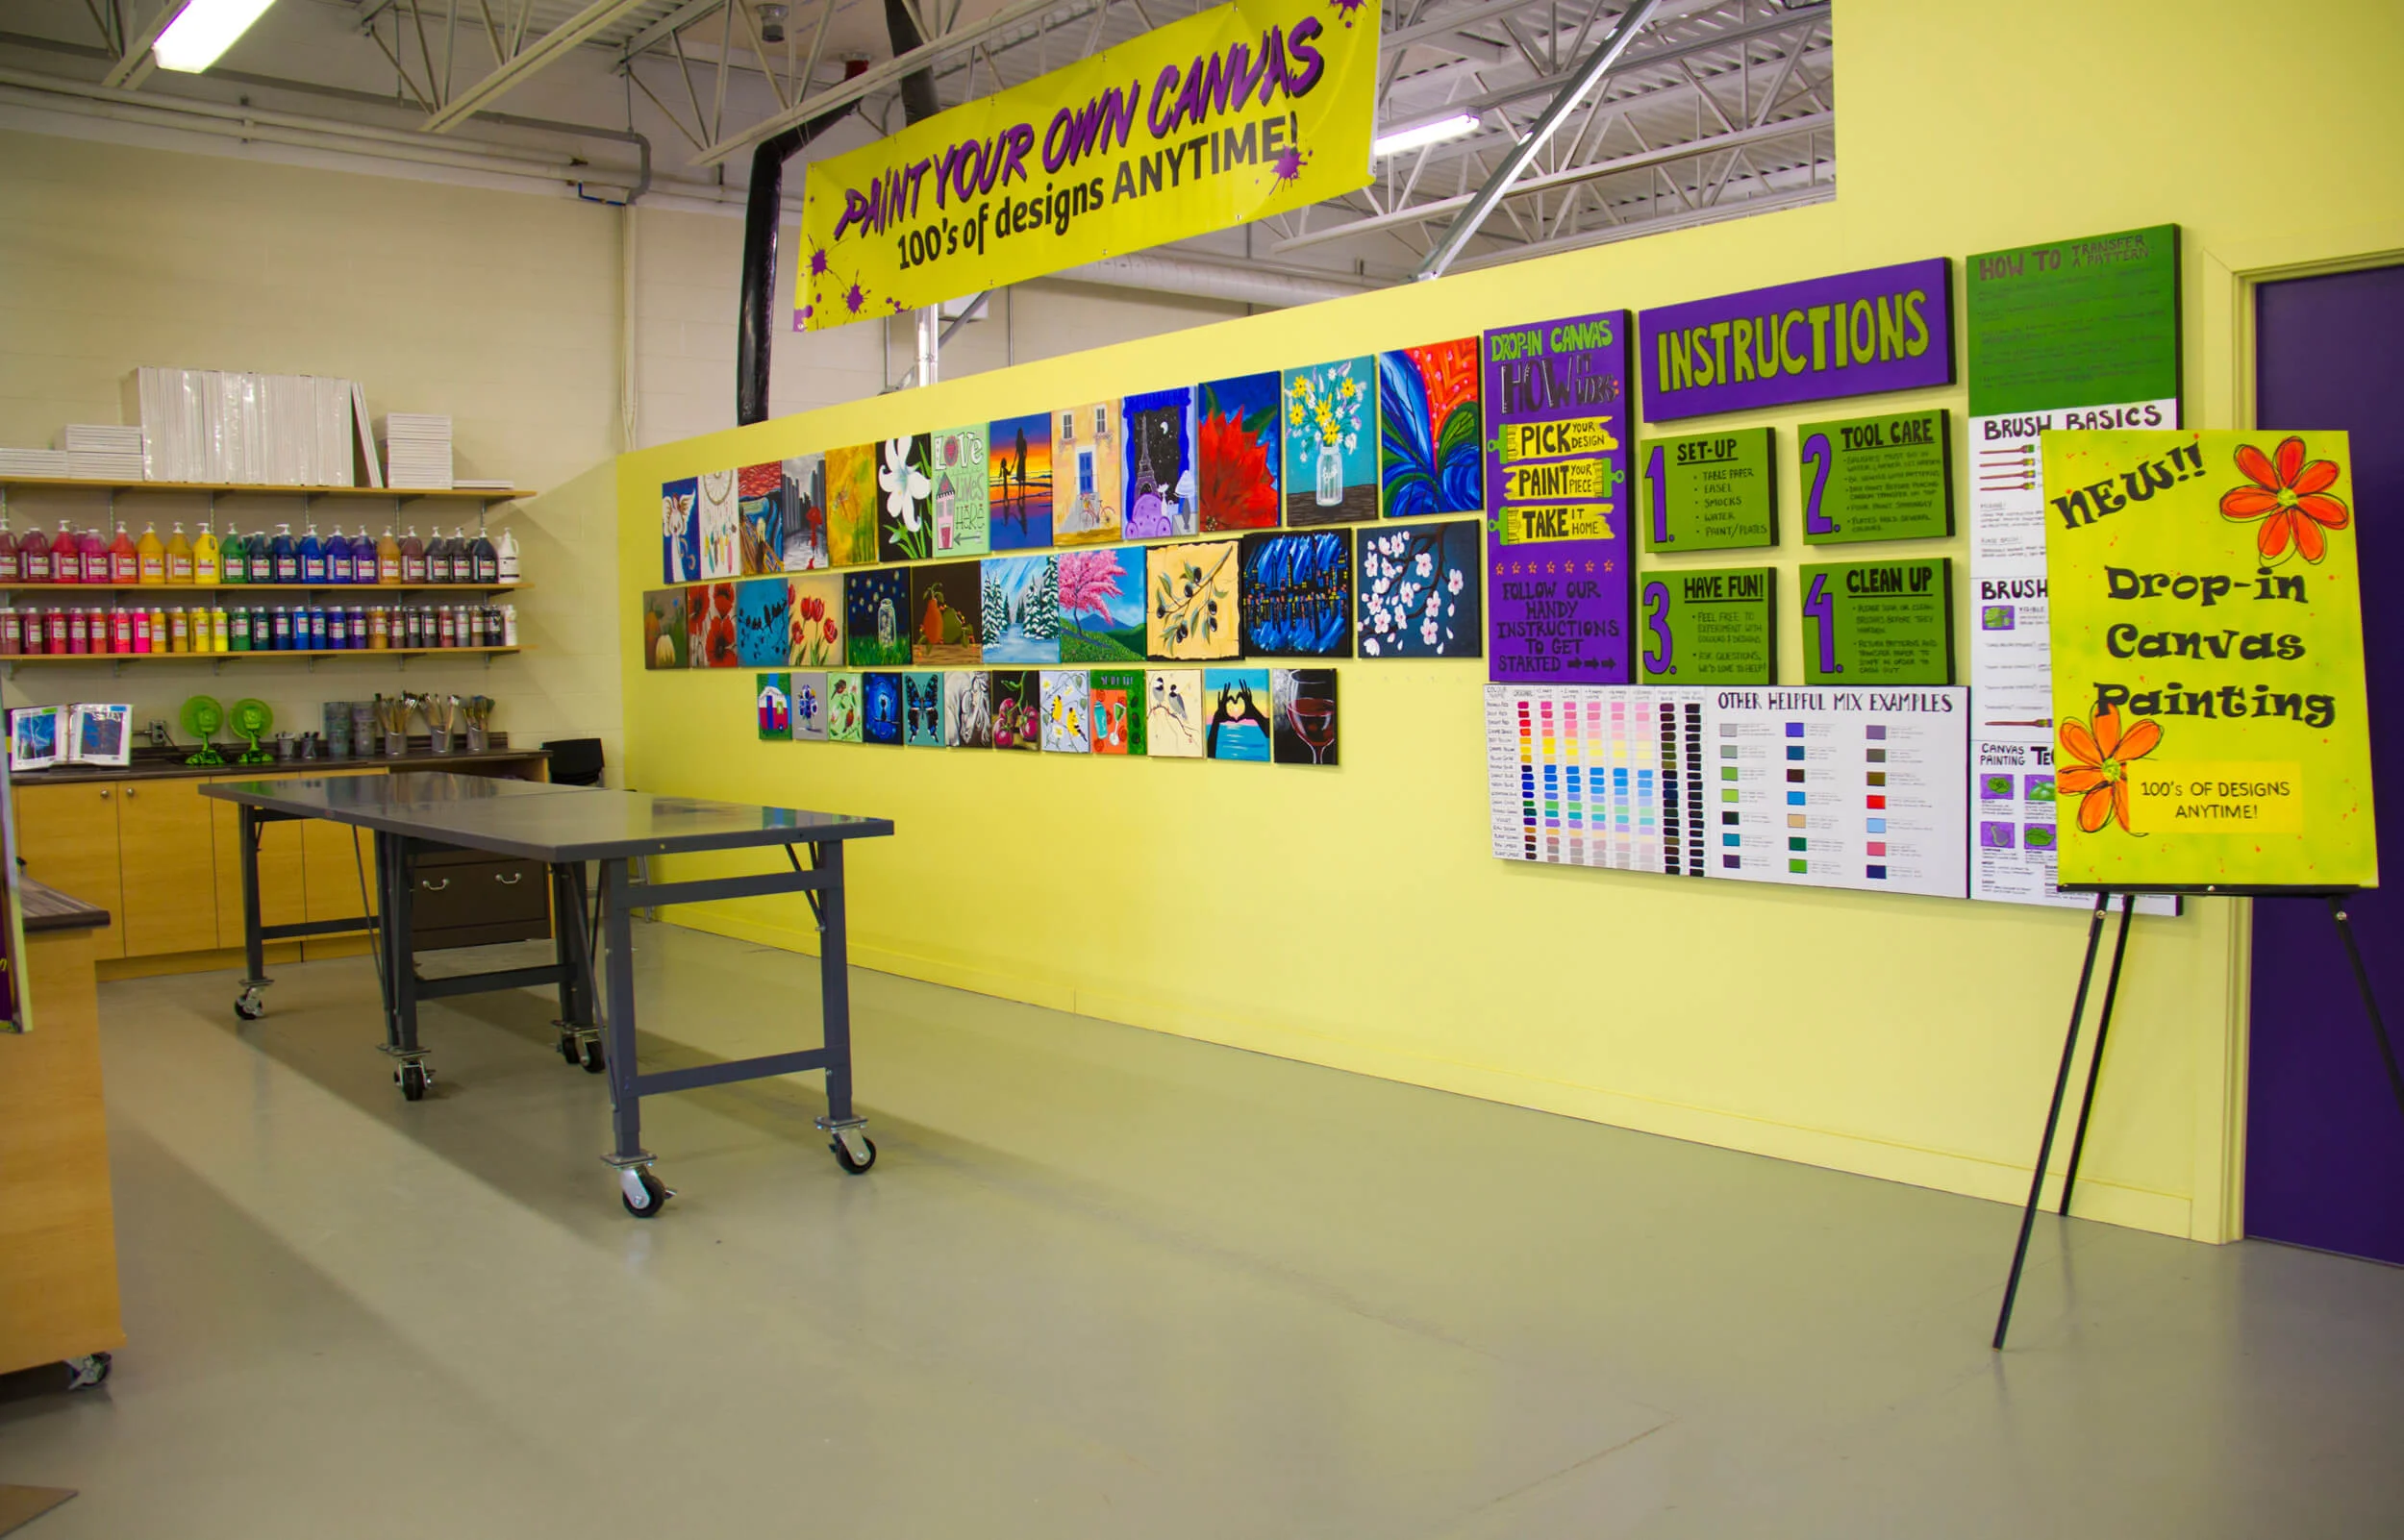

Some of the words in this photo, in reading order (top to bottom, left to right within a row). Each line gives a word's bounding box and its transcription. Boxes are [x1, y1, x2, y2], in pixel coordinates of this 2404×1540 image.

[834, 155, 931, 240] PAINT
[932, 123, 1035, 209] YOUR
[1041, 81, 1140, 173] OWN
[1147, 16, 1325, 138] CANVAS
[897, 218, 958, 270] 100's
[963, 214, 986, 255] of
[995, 177, 1104, 236] designs
[1111, 112, 1298, 205] ANYTIME!
[1979, 253, 2024, 281] HOW
[2031, 249, 2061, 271] TO
[2071, 234, 2146, 257] TRANSFER
[2072, 258, 2081, 268] A
[2087, 246, 2149, 266] PATTERN
[1490, 330, 1542, 361] DROP-IN
[1550, 320, 1613, 353] CANVAS
[1657, 289, 1929, 393] INSTRUCTIONS
[1501, 356, 1572, 414] HOW
[1572, 421, 1595, 433] YOUR
[1984, 414, 2051, 440] BRUSH
[2066, 405, 2163, 430] BASICS
[1521, 422, 1572, 456] PICK
[1571, 434, 1605, 448] DESIGN
[1841, 423, 1884, 449] TOOL
[1891, 418, 1933, 444] CARE
[1677, 438, 1738, 461] SET-UP
[1518, 464, 1569, 497] PAINT
[1570, 463, 1592, 477] YOUR
[1702, 470, 1727, 482] TABLE
[1729, 468, 1754, 480] PAPER
[1569, 479, 1592, 493] PIECE
[2050, 441, 2207, 530] NEW!!
[1704, 496, 1742, 509] SMOCKS
[1522, 509, 1568, 538] TAKE
[1572, 509, 1585, 520] IT
[1572, 521, 1599, 535] HOME
[1685, 576, 1722, 599] HAVE
[1729, 575, 1764, 597] FUN!
[1846, 567, 1903, 593] CLEAN
[1909, 566, 1932, 592] UP
[1981, 579, 2048, 600] BRUSH
[2104, 564, 2309, 608] Drop-in
[1502, 582, 1557, 600] FOLLOW
[1566, 581, 1601, 599] OUR
[1525, 601, 1578, 620] HANDY
[1497, 619, 1619, 638] INSTRUCTIONS
[1525, 638, 1544, 655] TO
[1551, 637, 1584, 655] GET
[2107, 623, 2306, 660] Canvas
[1498, 656, 1561, 672] STARTED
[1717, 691, 1763, 709] OTHER
[1767, 691, 1826, 710] HELPFUL
[1834, 692, 1864, 710] MIX
[1869, 693, 1953, 712] EXAMPLES
[2092, 682, 2336, 728] Painting
[1982, 743, 2024, 755] CANVAS
[2031, 746, 2054, 765] TE
[1980, 755, 2026, 766] PAINTING
[2141, 781, 2184, 797] 100's
[2191, 781, 2213, 797] OF
[2217, 781, 2291, 798] DESIGNS
[2175, 804, 2259, 820] ANYTIME!
